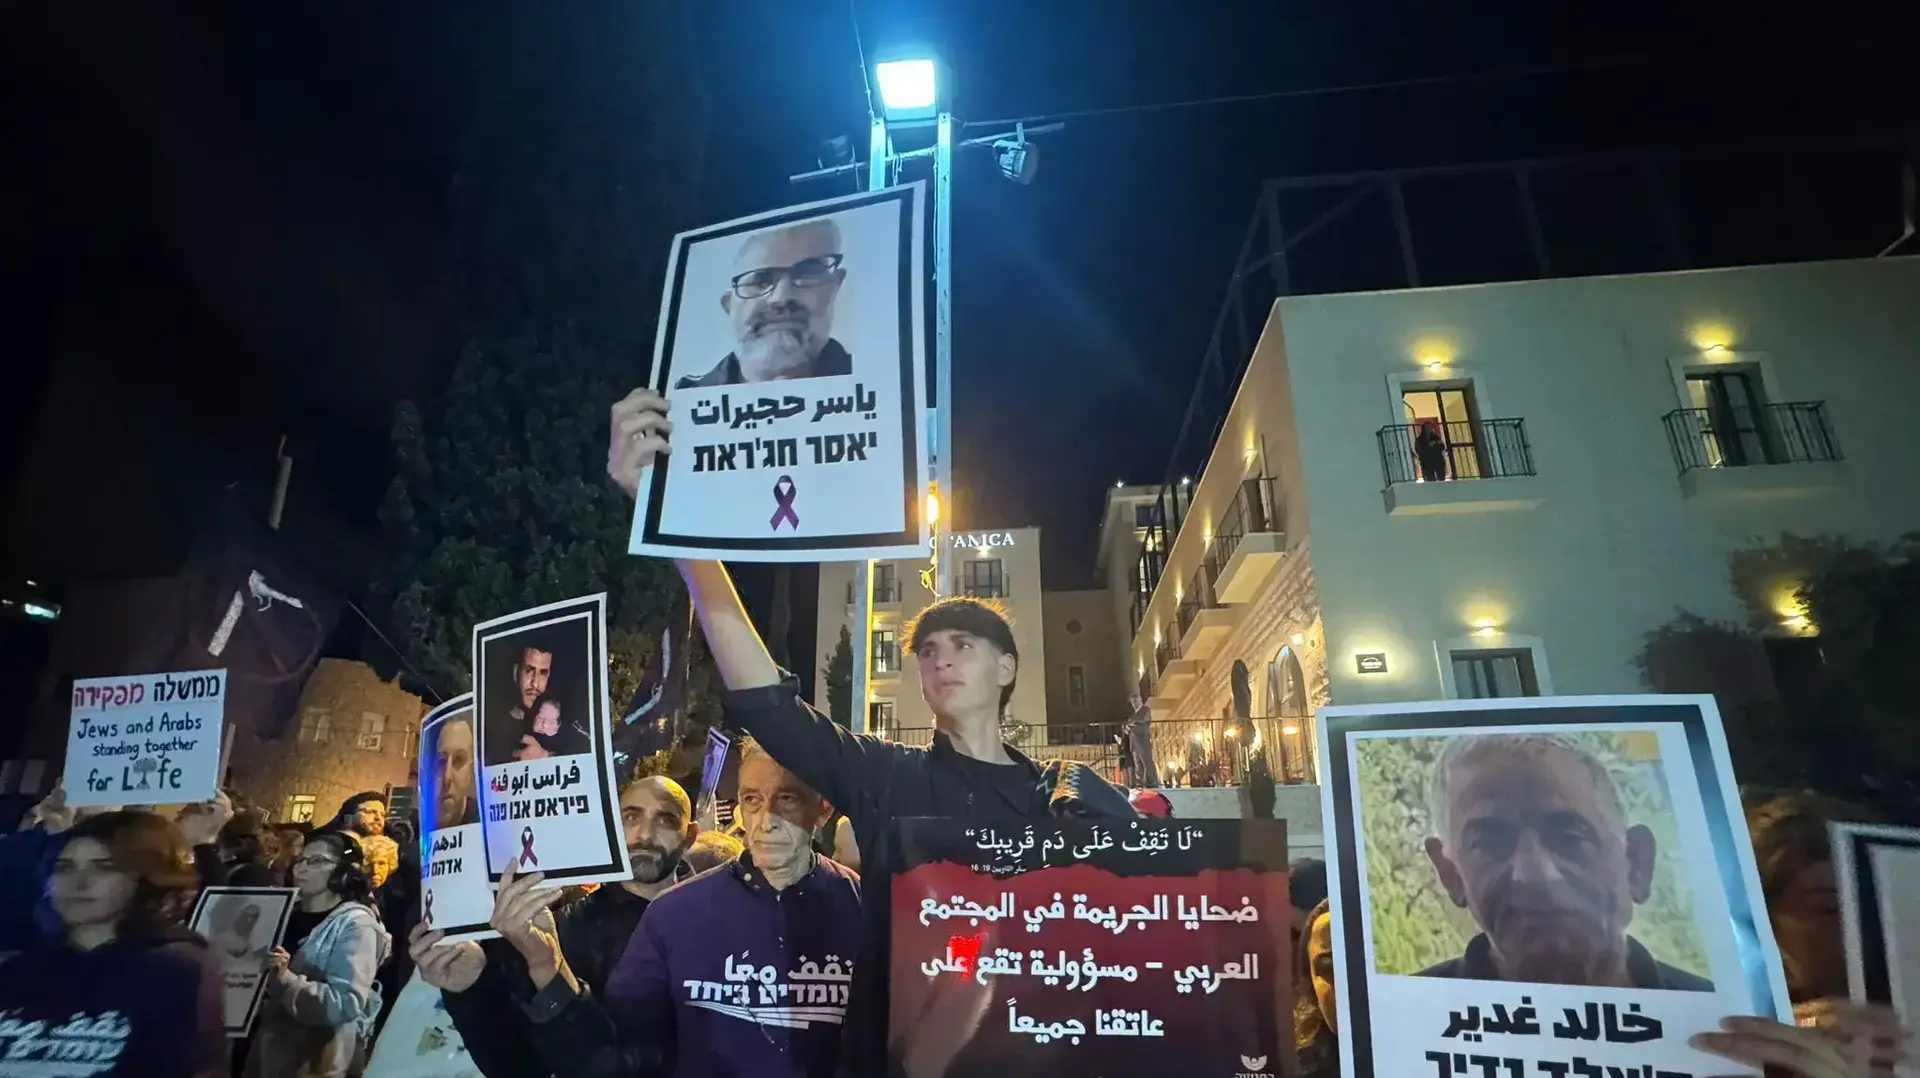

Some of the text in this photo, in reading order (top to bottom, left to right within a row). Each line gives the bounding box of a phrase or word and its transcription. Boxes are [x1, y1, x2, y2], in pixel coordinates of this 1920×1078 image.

[691, 383, 877, 429] ياسر حجيرات
[693, 432, 877, 472] יאסר חג'ראת
[74, 674, 220, 711] ממשלה מפקירה
[77, 712, 202, 739] Jews and Arabs
[92, 736, 198, 760] standing together
[87, 768, 113, 792] for
[512, 766, 529, 796] أبو
[532, 760, 581, 790] فراس
[489, 795, 589, 822] פיראס אבו פנה
[432, 831, 463, 857] ادهم
[431, 858, 463, 876] אדהם
[918, 892, 1259, 935] ضحايا الجريمة في المجتمع
[921, 947, 969, 977] على
[975, 948, 1023, 986] تقع
[1030, 947, 1138, 991] مسؤولية
[1173, 953, 1259, 994] العربي
[683, 980, 750, 1004] ביחד
[1095, 1008, 1165, 1036] عاتقنا
[1441, 996, 1663, 1043] خالد غدير
